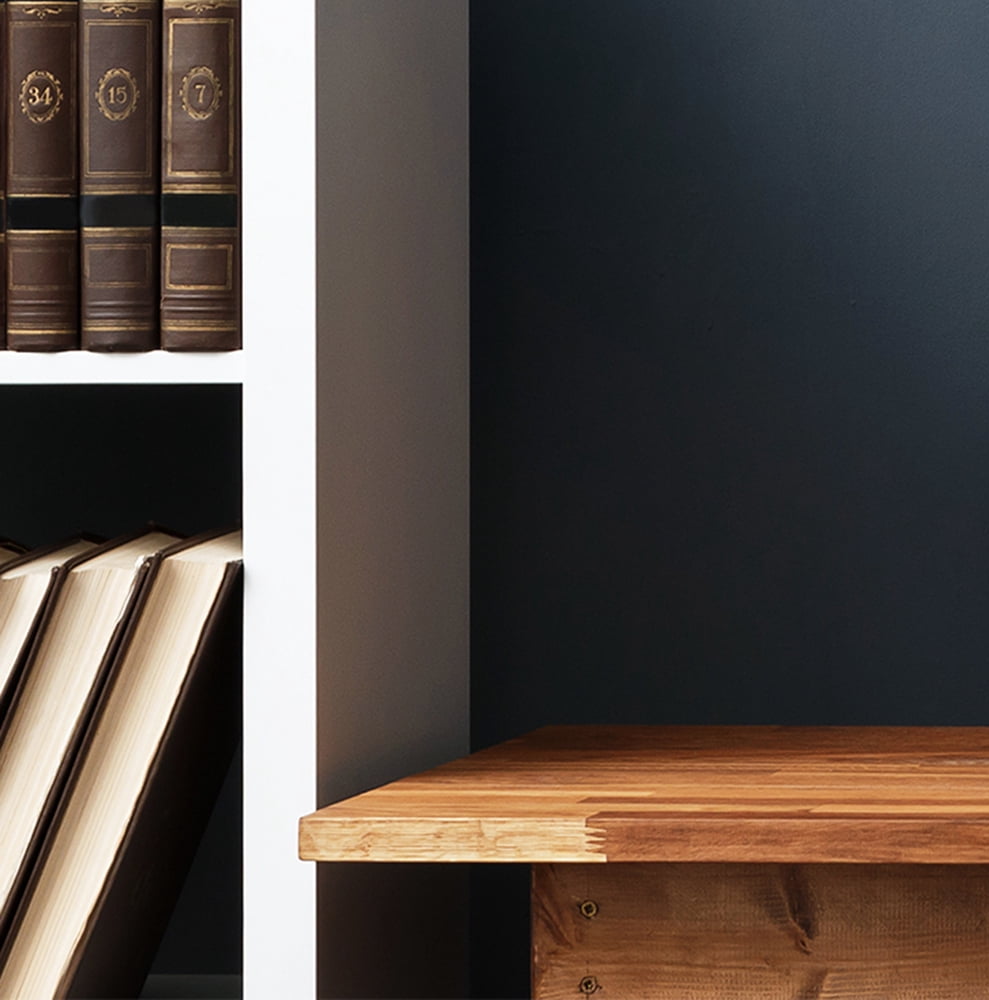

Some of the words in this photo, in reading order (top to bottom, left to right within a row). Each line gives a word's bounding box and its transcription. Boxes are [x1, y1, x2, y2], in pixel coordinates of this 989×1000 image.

[28, 86, 53, 106] 34
[108, 86, 128, 104] 15
[194, 84, 207, 104] 7
